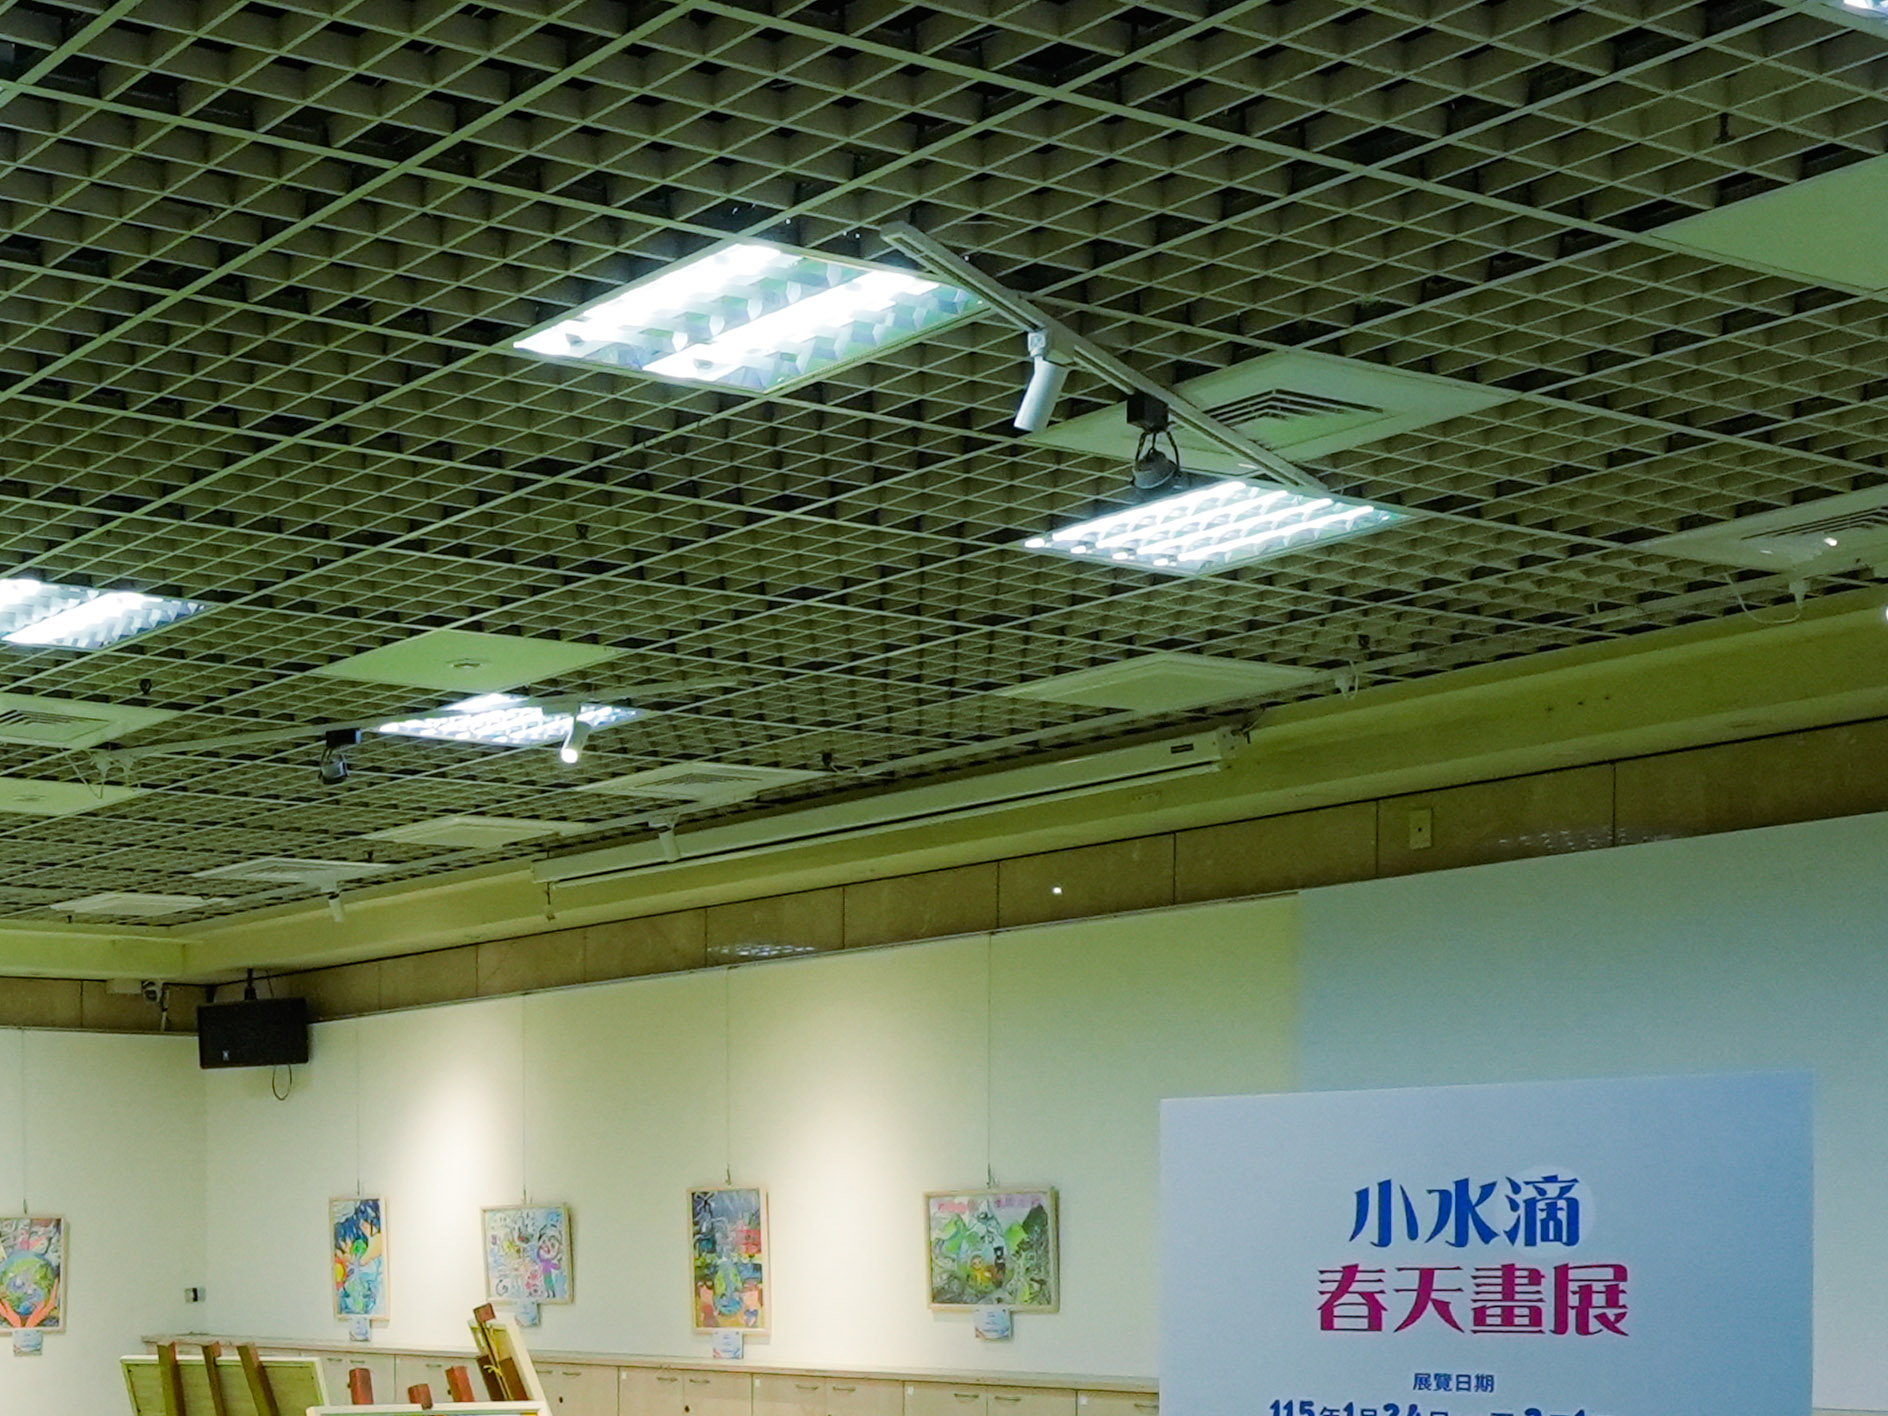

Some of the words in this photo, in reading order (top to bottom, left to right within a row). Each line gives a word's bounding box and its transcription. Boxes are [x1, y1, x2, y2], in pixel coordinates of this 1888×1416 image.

[1348, 1174, 1581, 1249] 小水滴
[1316, 1262, 1630, 1337] 春天畫展
[1412, 1371, 1496, 1394] 展覽日期
